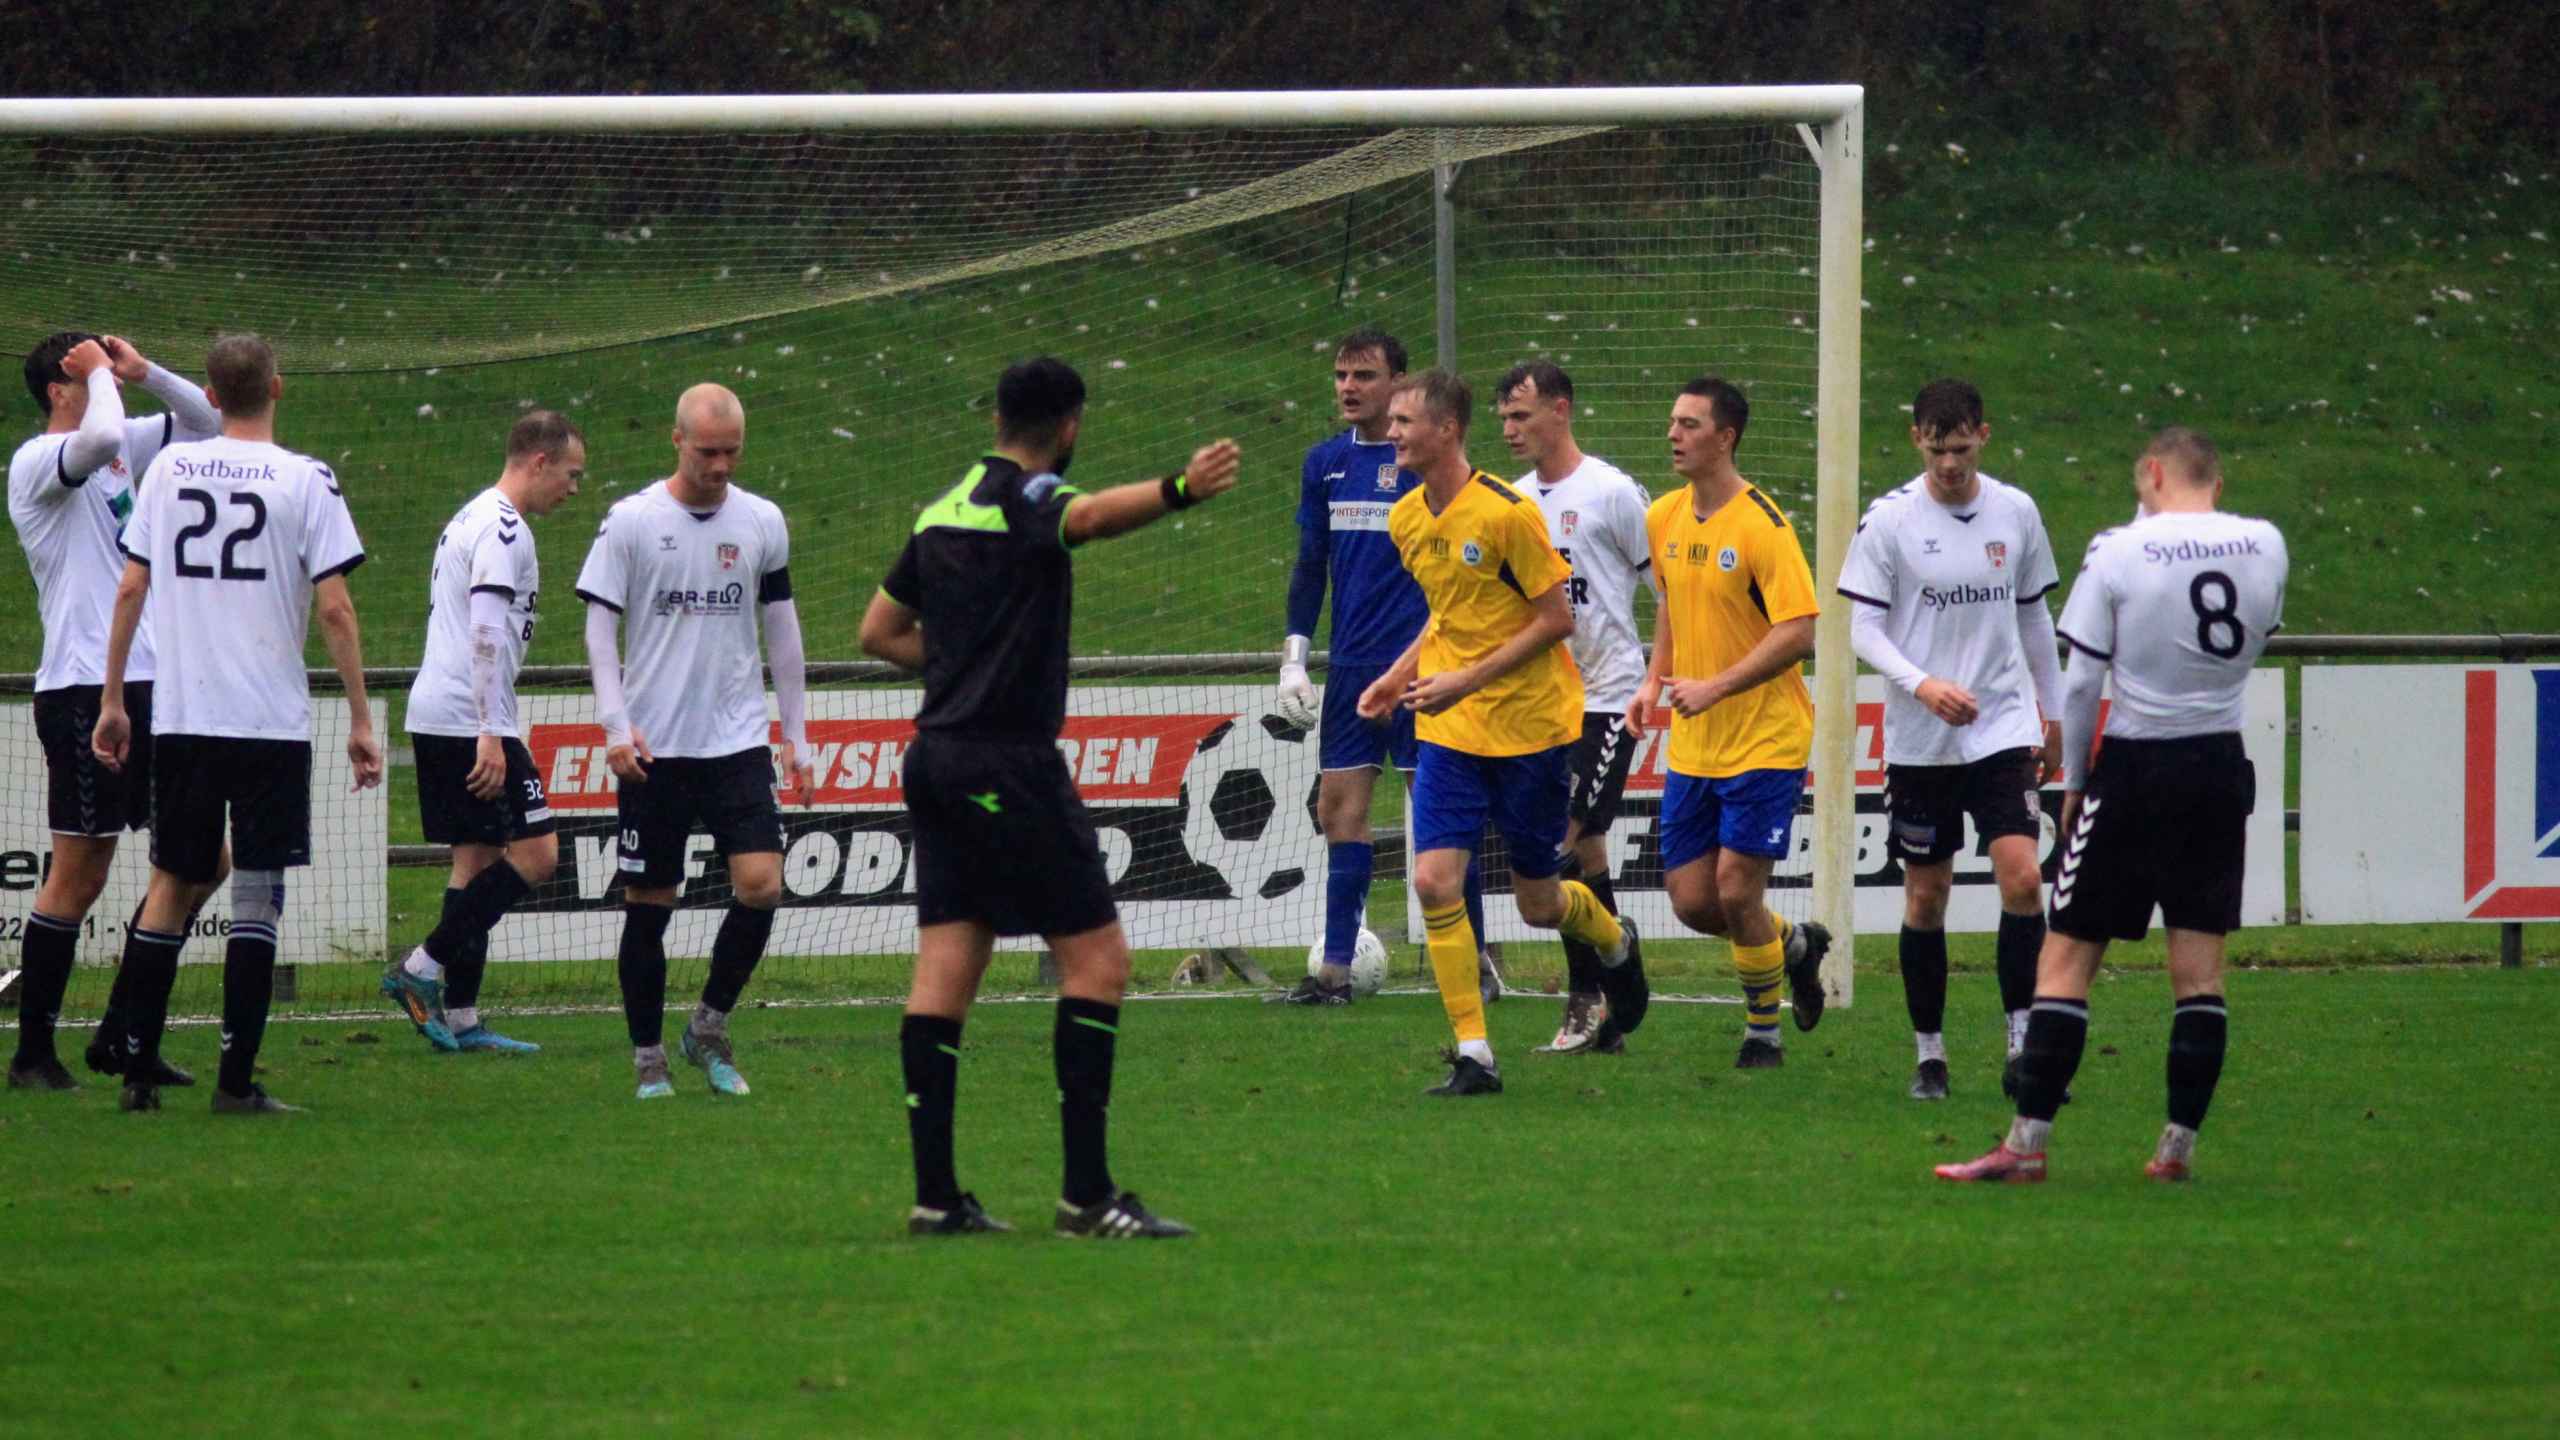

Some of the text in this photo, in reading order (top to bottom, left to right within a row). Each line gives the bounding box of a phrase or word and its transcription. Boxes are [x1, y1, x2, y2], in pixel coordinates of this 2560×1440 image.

[173, 456, 278, 482] Sydbank
[1336, 507, 1390, 518] INTERSPOR
[174, 488, 267, 581] 22
[2143, 536, 2262, 567] Sydbank
[2190, 570, 2244, 660] 8
[524, 779, 544, 801] 32
